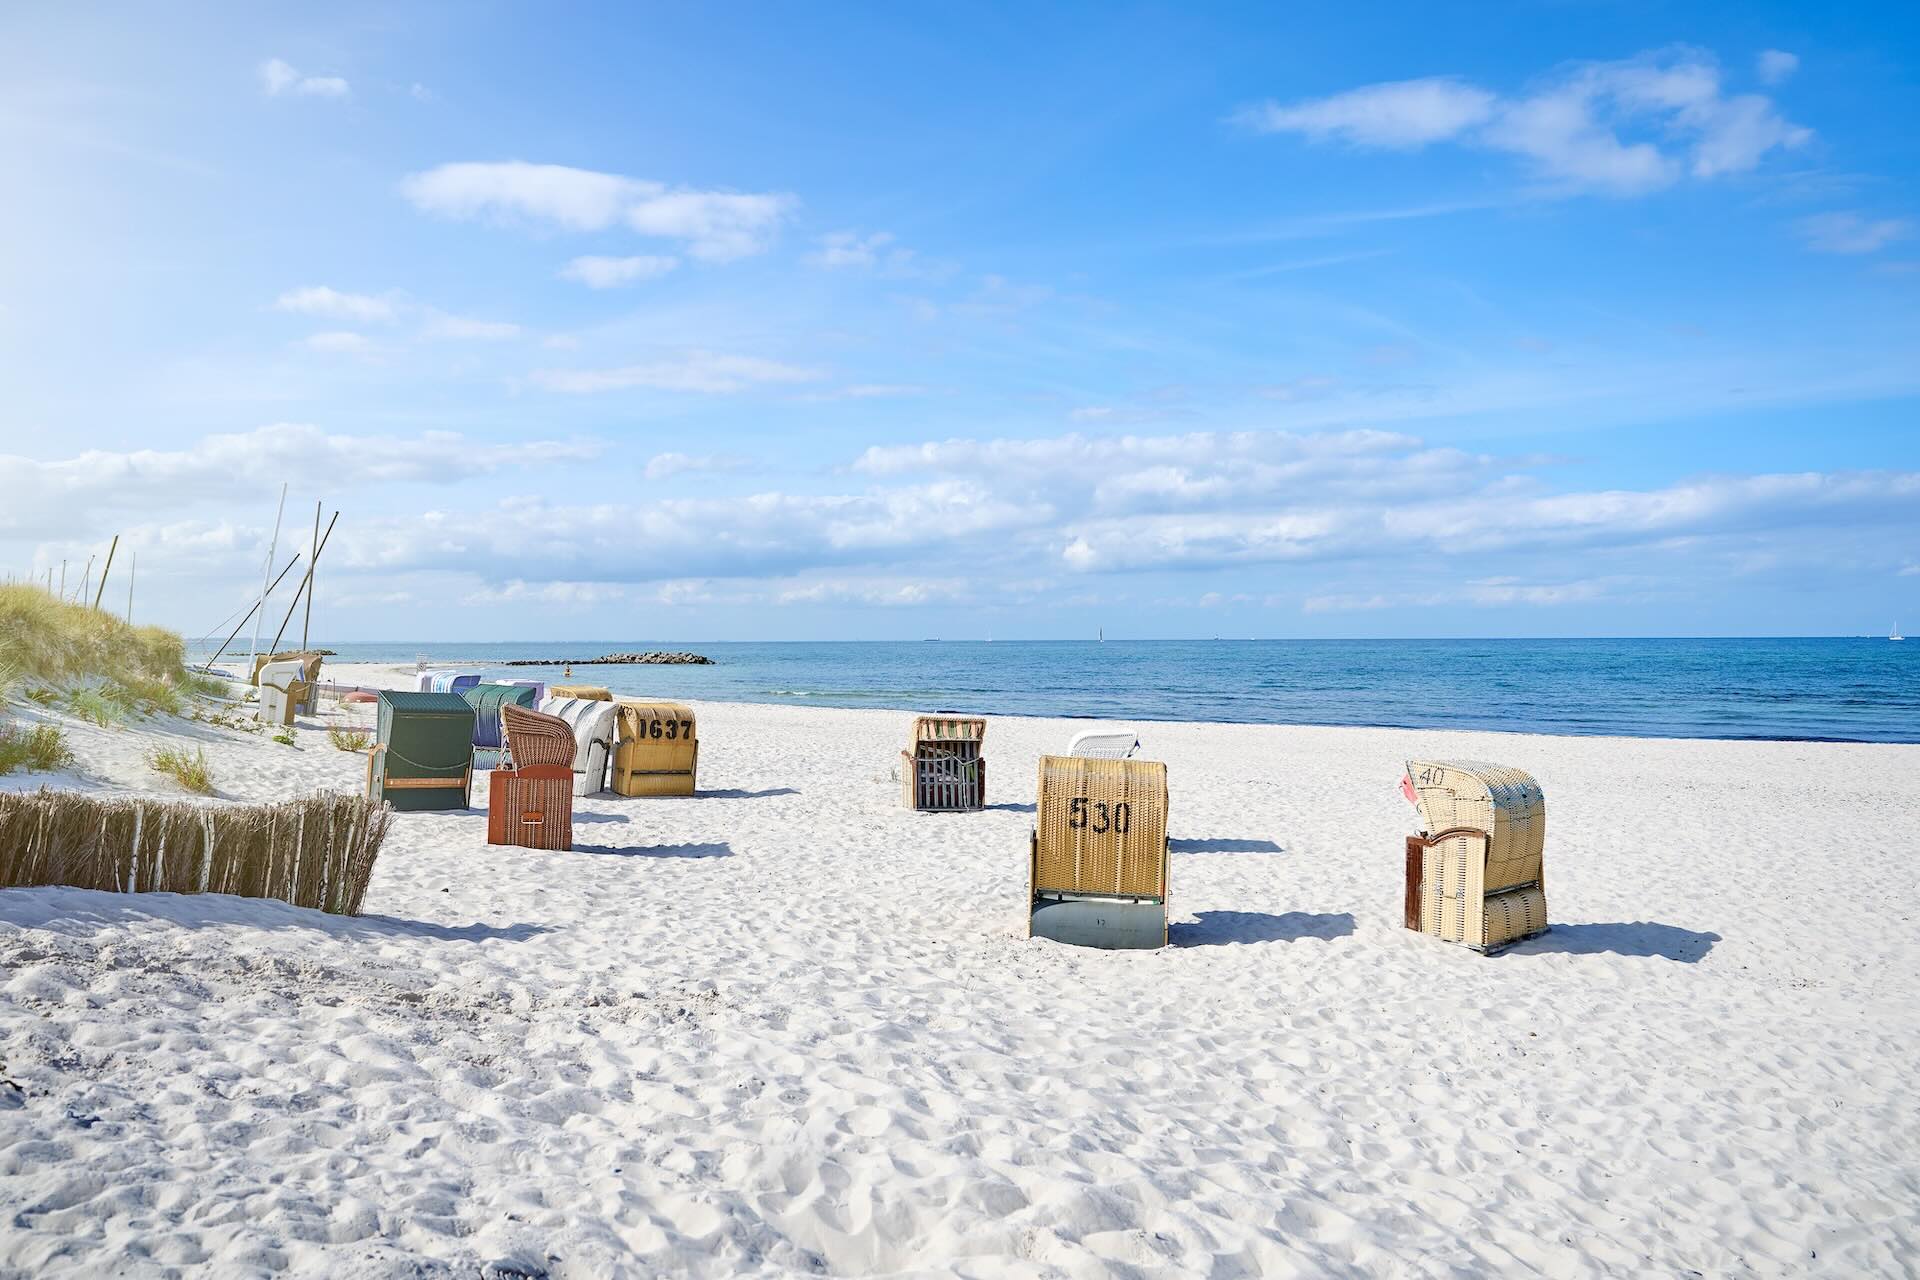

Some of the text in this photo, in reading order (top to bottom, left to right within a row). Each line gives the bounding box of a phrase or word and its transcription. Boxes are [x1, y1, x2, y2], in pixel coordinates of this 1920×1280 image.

[640, 719, 692, 739] 1637
[1420, 767, 1444, 785] 40
[1070, 797, 1130, 834] 530
